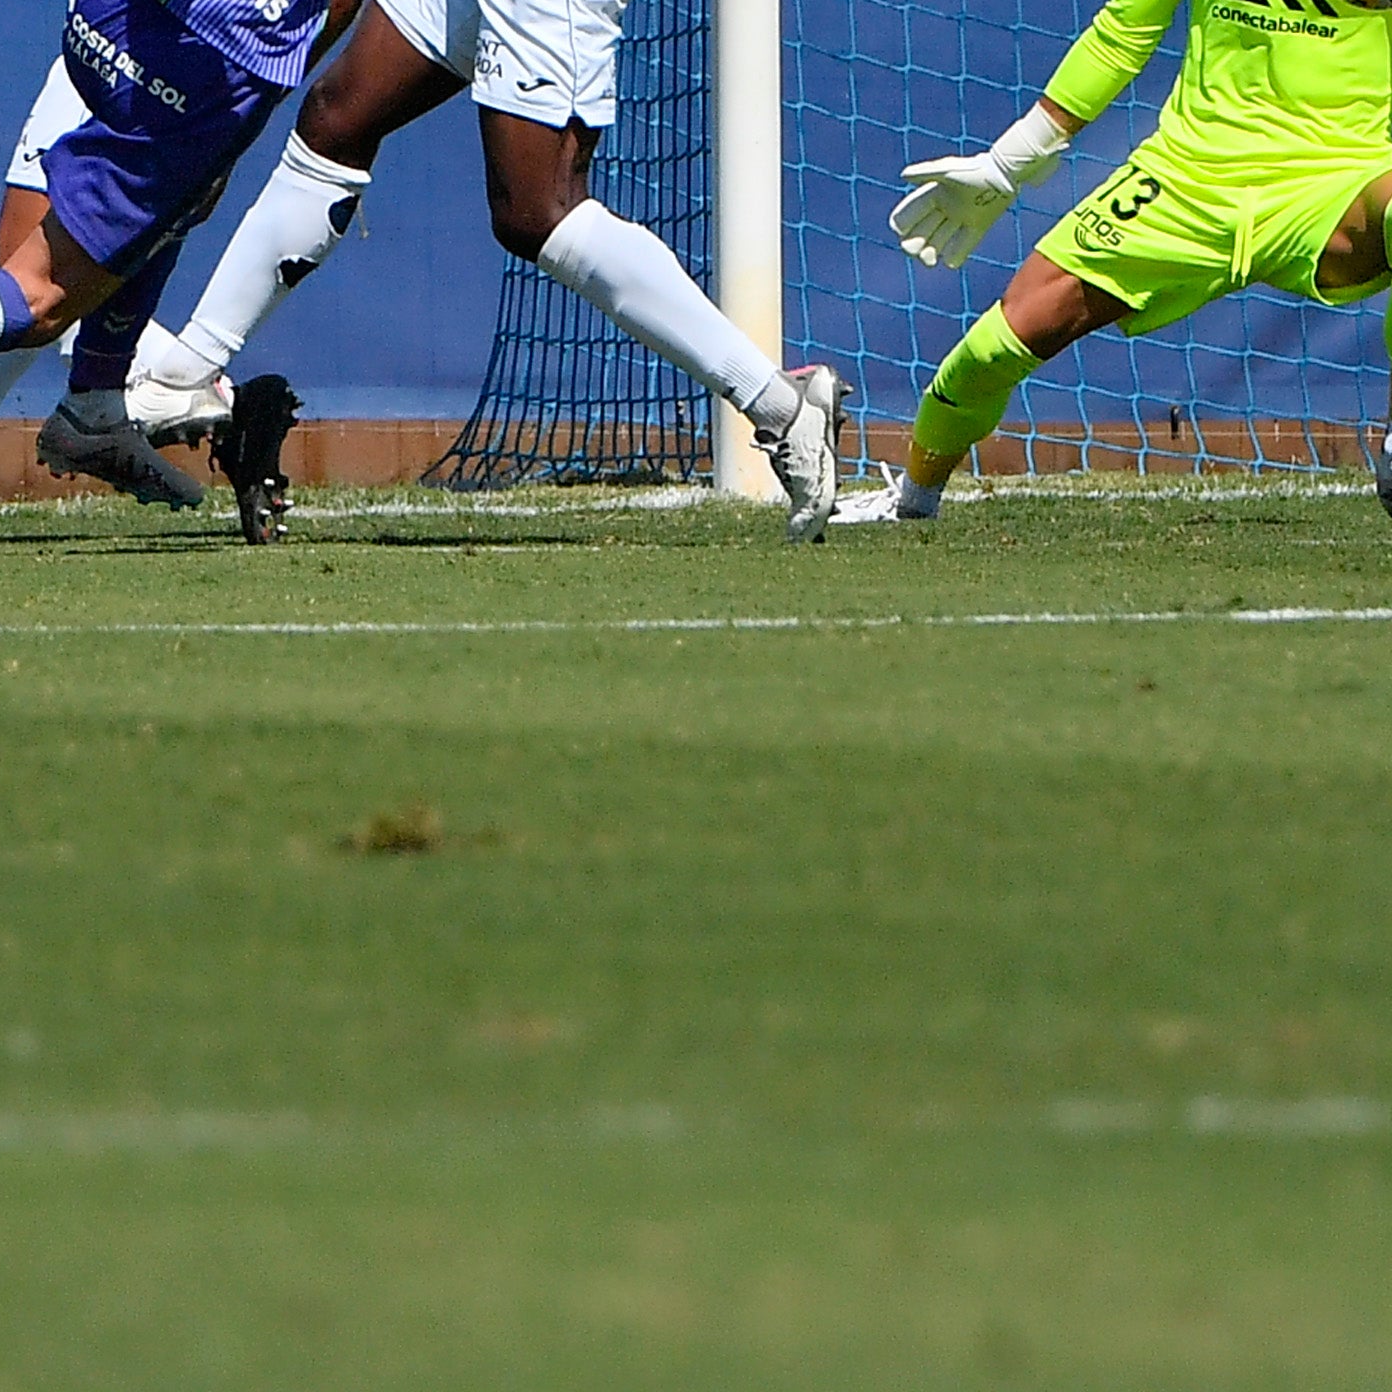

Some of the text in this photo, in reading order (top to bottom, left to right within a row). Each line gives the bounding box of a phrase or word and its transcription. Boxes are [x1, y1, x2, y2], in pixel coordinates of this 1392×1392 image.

[1211, 3, 1339, 40] conectabalear
[72, 13, 187, 114] COSTA DEL SOL
[1096, 166, 1161, 221] 13
